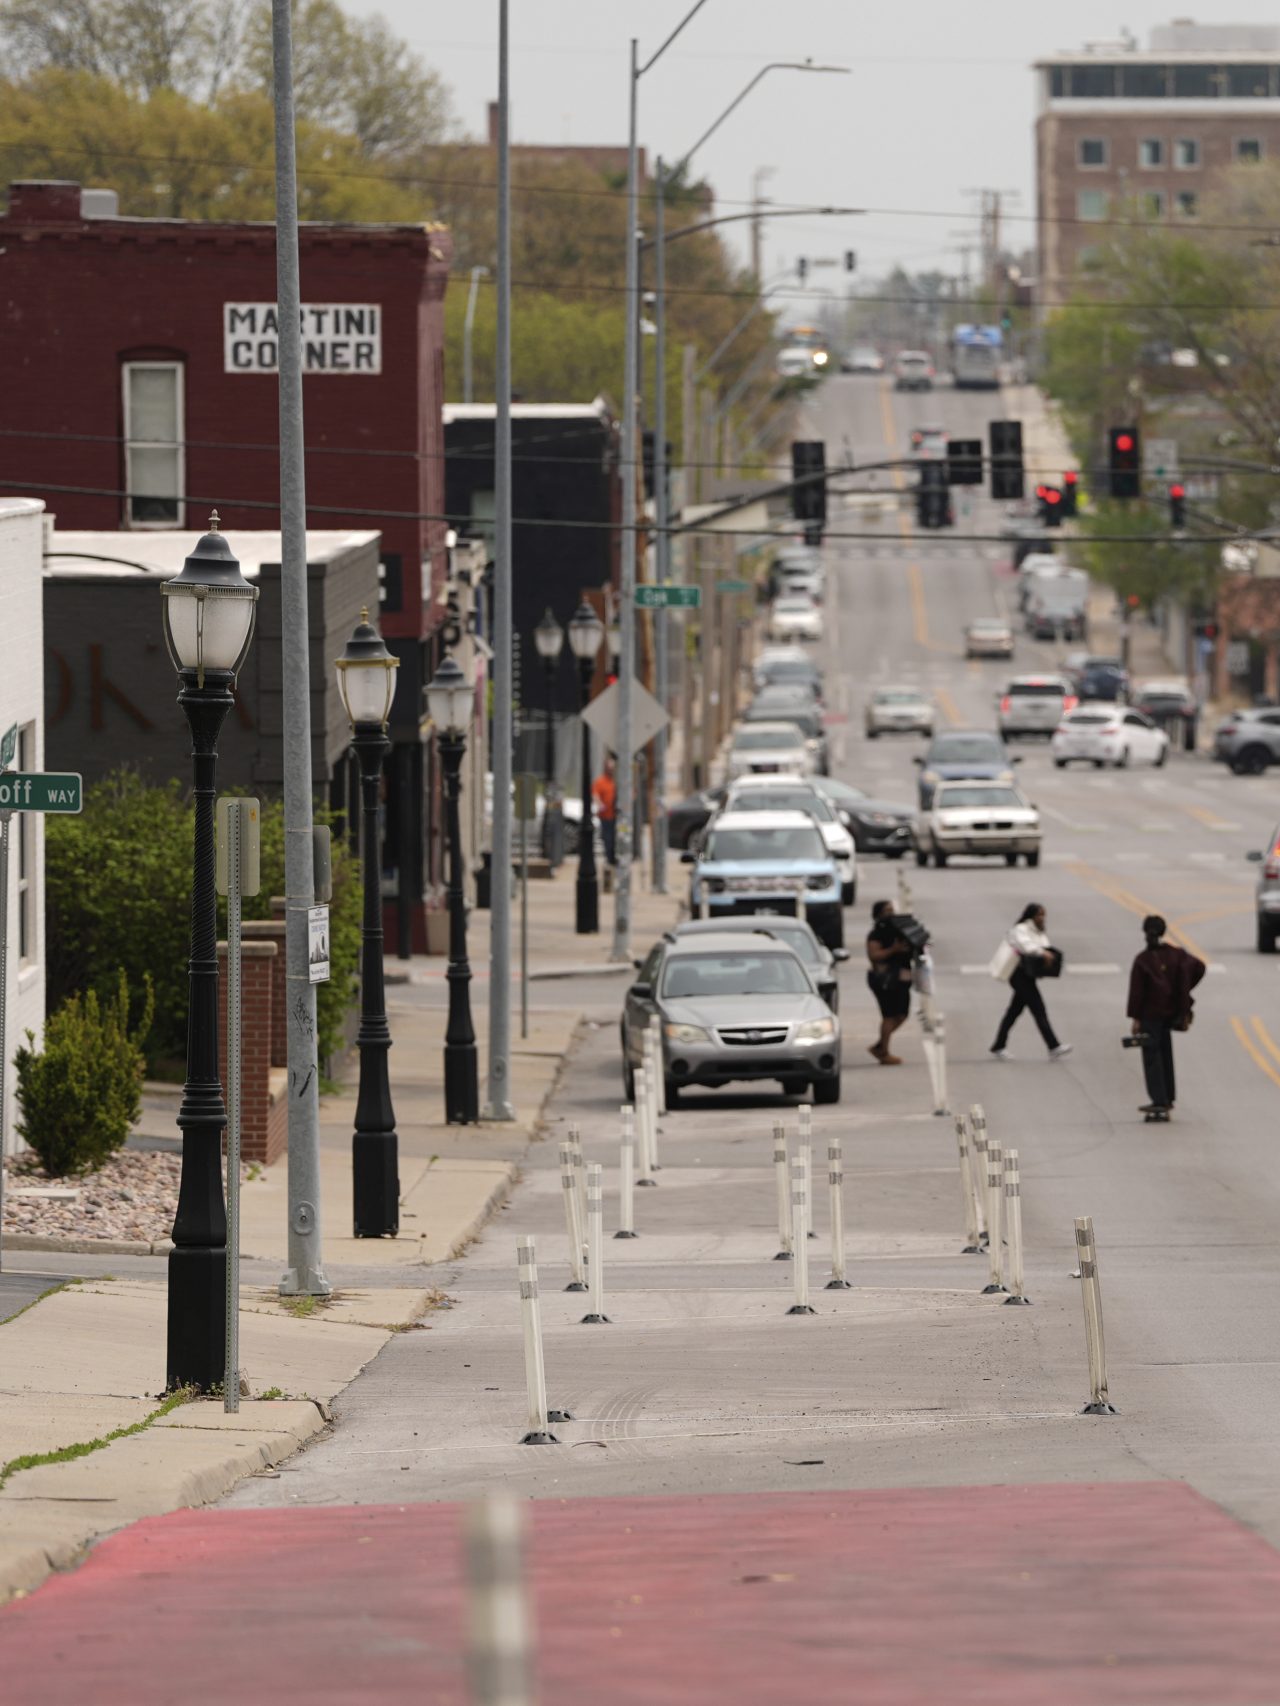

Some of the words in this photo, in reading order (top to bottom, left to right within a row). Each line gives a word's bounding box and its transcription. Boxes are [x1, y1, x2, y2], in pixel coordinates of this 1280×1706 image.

[229, 308, 376, 335] MATINI
[232, 341, 374, 369] CONER
[47, 789, 76, 803] WAY
